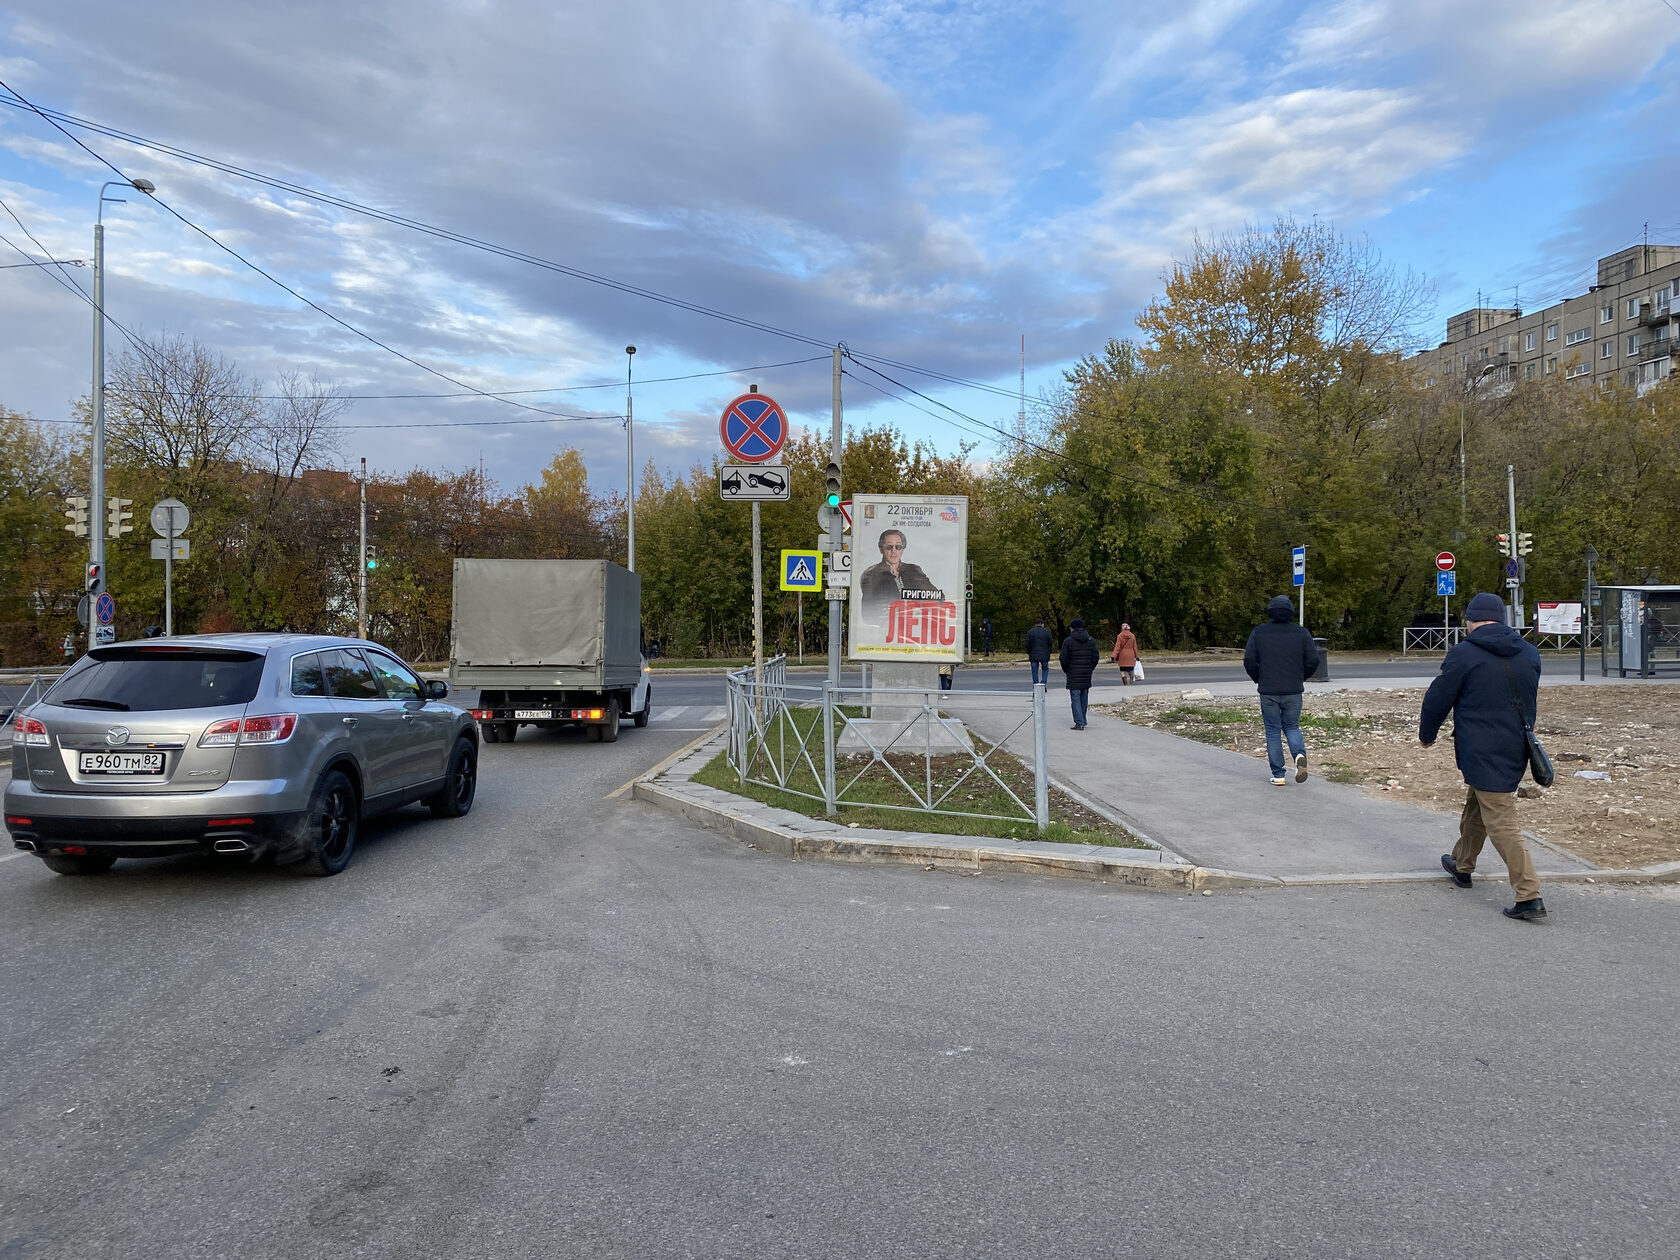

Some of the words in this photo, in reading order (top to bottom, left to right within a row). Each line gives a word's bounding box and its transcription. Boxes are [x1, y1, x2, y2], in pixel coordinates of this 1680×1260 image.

[888, 504, 900, 515] 22
[901, 506, 933, 516] ОКТЯБРЯ
[886, 601, 956, 645] ЛЕПС
[144, 755, 158, 766] 82
